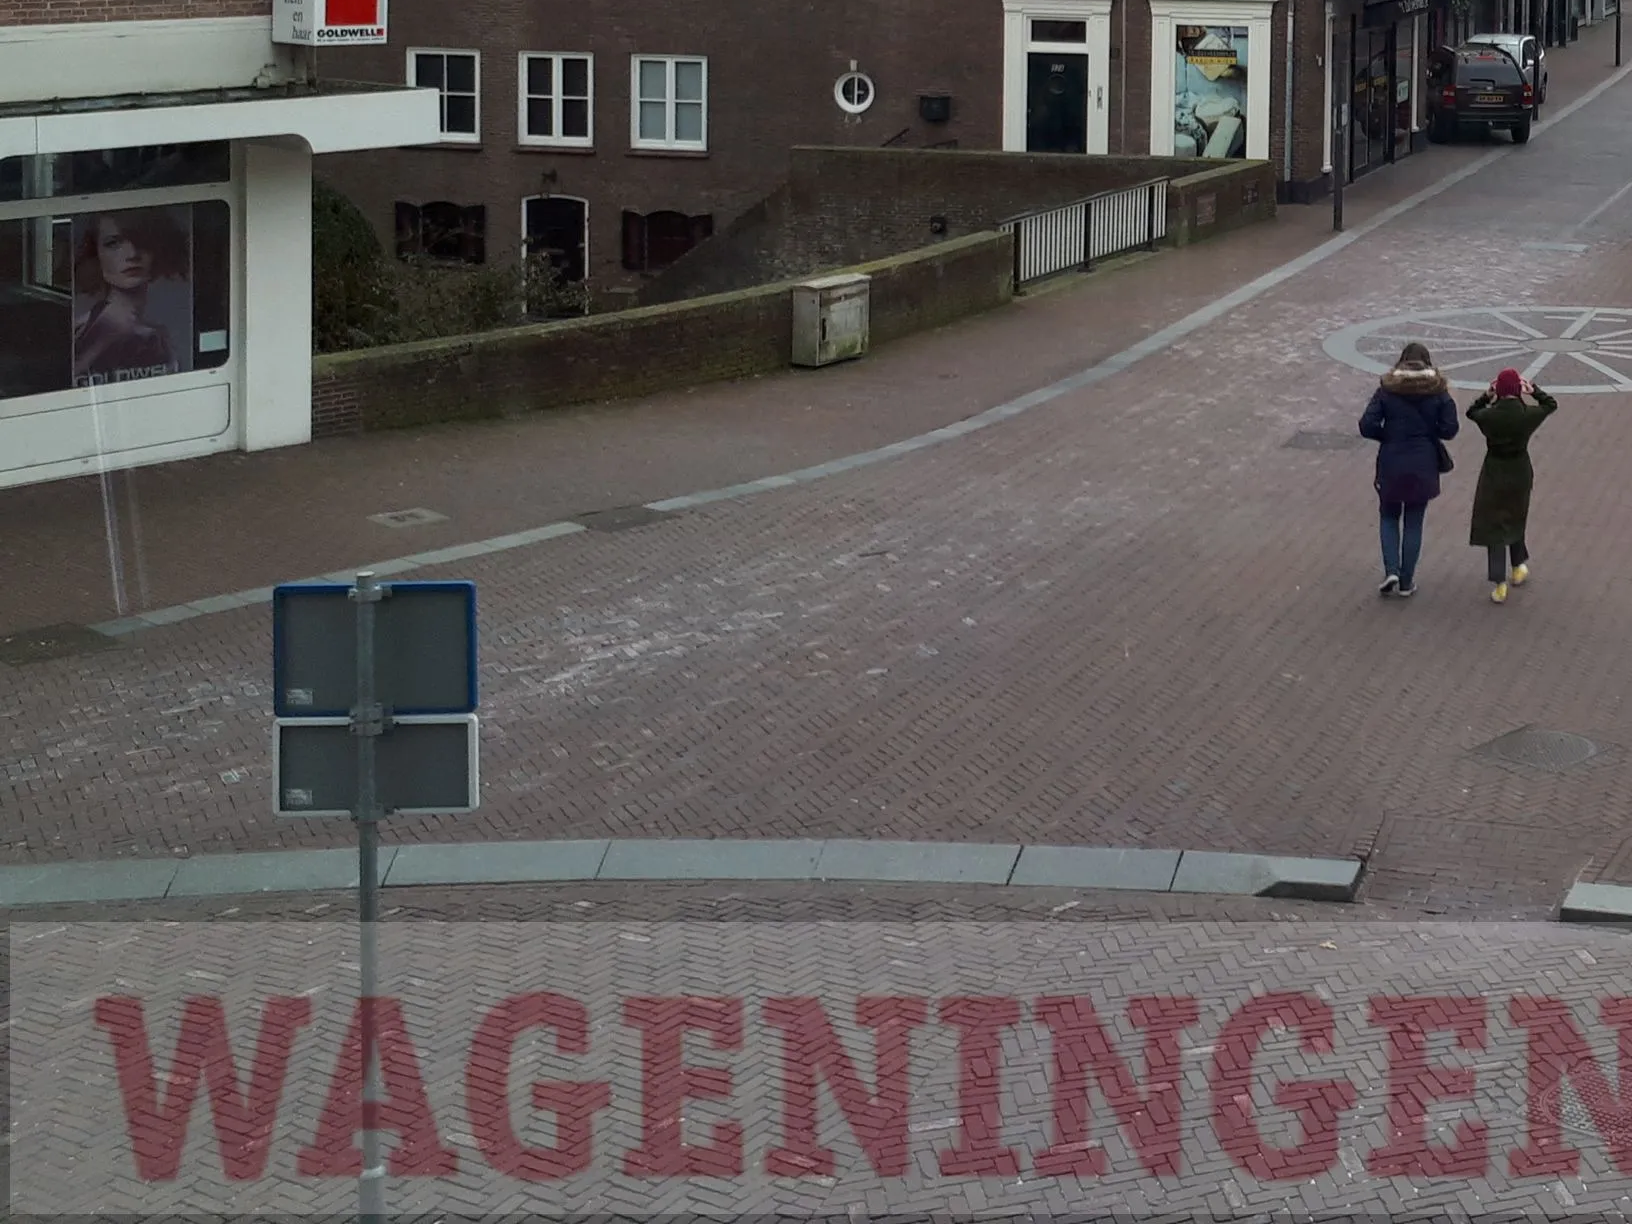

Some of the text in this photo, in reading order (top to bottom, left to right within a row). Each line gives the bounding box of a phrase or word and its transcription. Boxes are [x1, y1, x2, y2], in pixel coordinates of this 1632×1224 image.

[292, 11, 304, 24] en
[291, 25, 313, 41] haar
[316, 28, 378, 38] GOLDWELL
